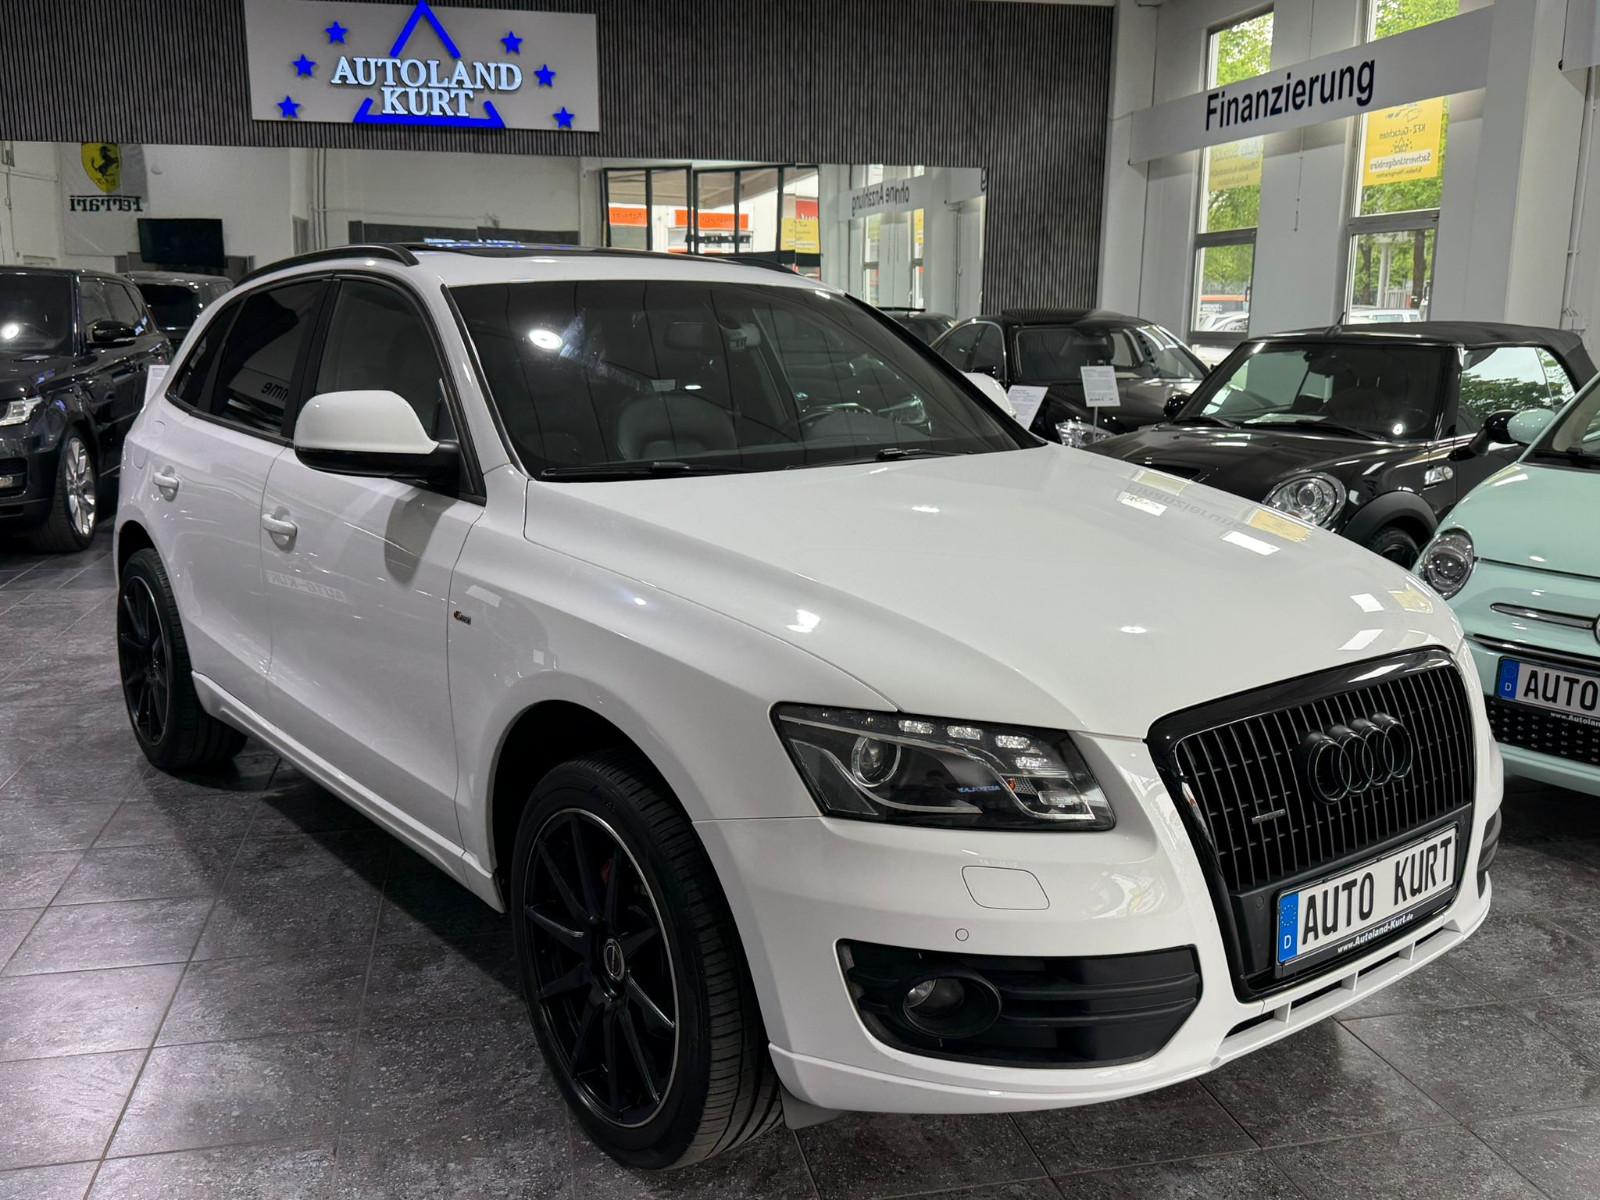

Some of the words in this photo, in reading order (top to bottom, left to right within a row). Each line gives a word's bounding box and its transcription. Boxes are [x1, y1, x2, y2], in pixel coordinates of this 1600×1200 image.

[330, 55, 524, 92] AUTOLAND
[381, 86, 474, 117] KURT
[1205, 59, 1376, 132] Finanzierung
[1504, 682, 1512, 692] D
[1522, 669, 1599, 712] AUTO
[1283, 934, 1292, 950] D
[1301, 872, 1375, 946] AUTO
[1393, 835, 1453, 906] KURT
[1336, 912, 1414, 954] www.Autoland-Kurt.de
